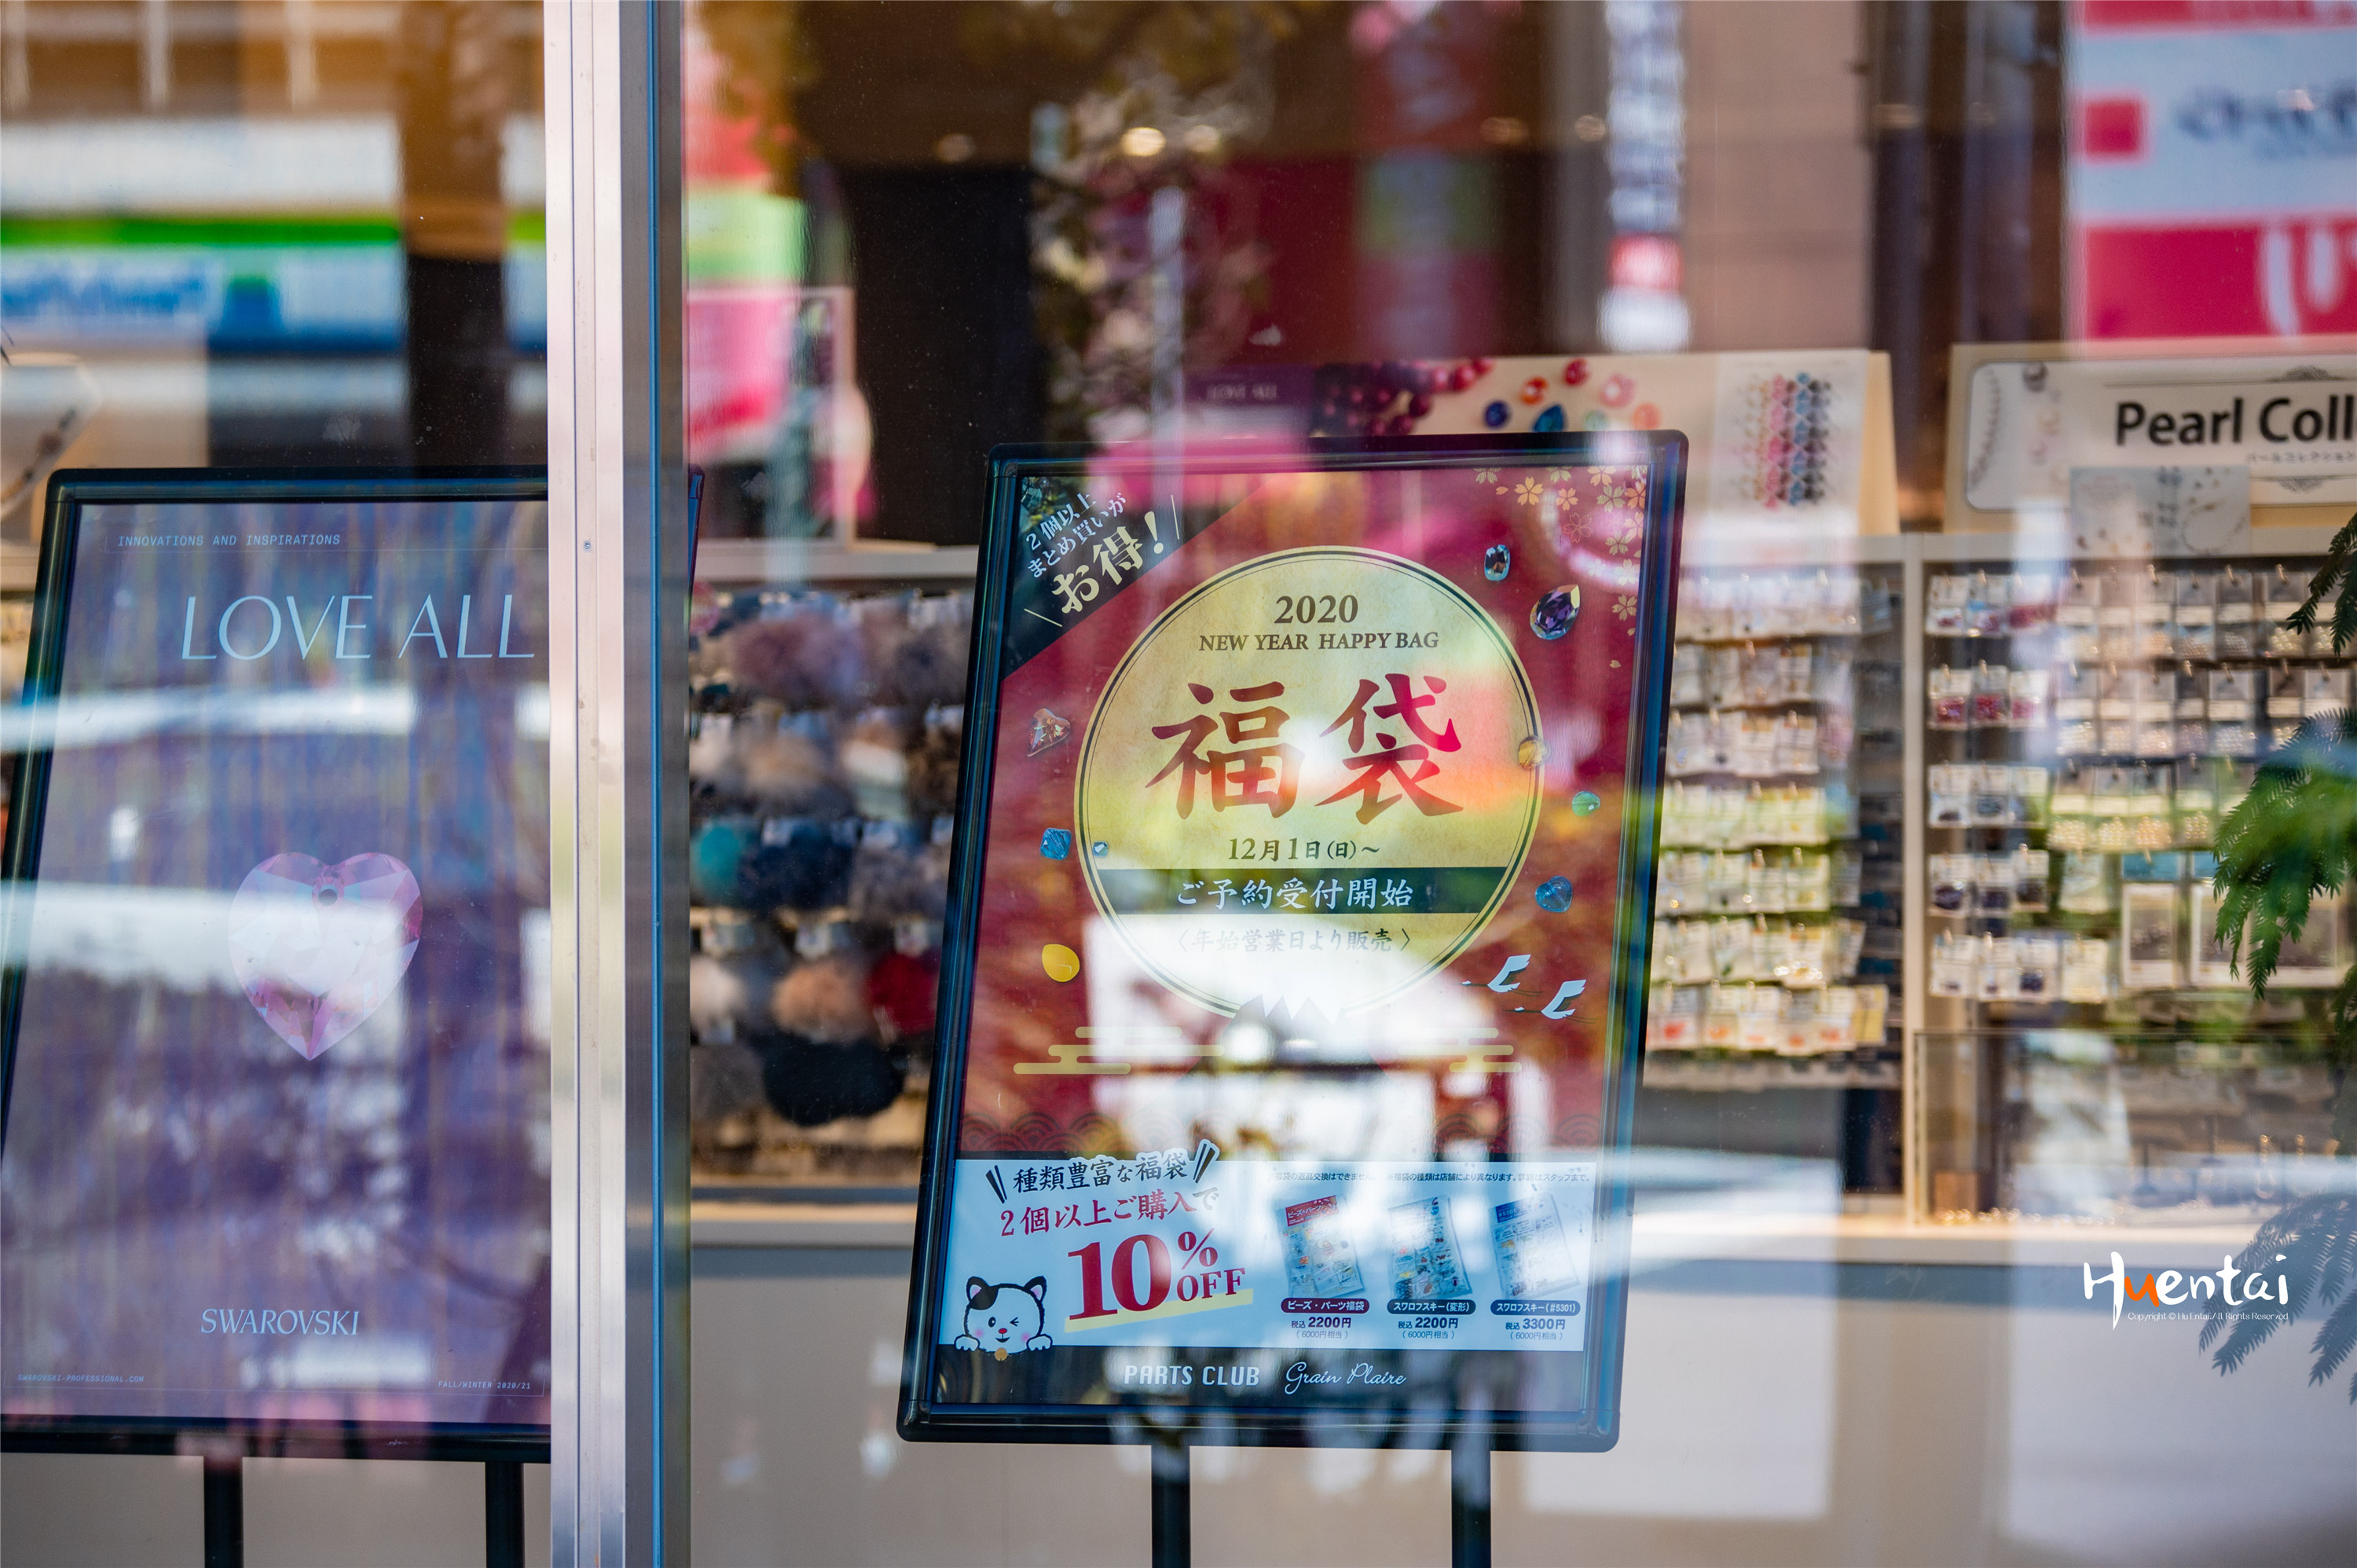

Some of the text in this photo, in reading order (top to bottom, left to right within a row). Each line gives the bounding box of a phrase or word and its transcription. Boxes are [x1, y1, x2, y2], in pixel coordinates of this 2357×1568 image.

[2116, 397, 2244, 446] Pearl
[1025, 492, 1097, 551] 2個以上
[1027, 492, 1127, 578] まとめ買いが
[118, 534, 340, 547] INNOVATIONS AND INSPIRATIONS
[1274, 595, 1359, 624] 2020
[181, 594, 535, 661] LOVE ALL
[1199, 631, 1439, 652] NEW YEAR HAPPY BAG
[1145, 673, 1464, 825] 福袋
[1177, 878, 1414, 910] ご予約受付開始
[1013, 1152, 1189, 1193] 種類豊富な福袋
[1000, 1187, 1220, 1237] 2個以上ご購入で
[1176, 1267, 1245, 1302] OFF
[200, 1308, 360, 1336] SWAROVSKI
[1308, 1317, 1351, 1328] 2200円
[1415, 1317, 1458, 1329] 2200円
[1523, 1318, 1566, 1330] 3300円
[17, 1374, 145, 1383] SWAROVSKI-PROFESSIONAL.COM
[438, 1380, 492, 1390] FALL/WINTER
[1124, 1365, 1260, 1387] PARTS CLUB
[1284, 1361, 1407, 1395] Grain Plaire
